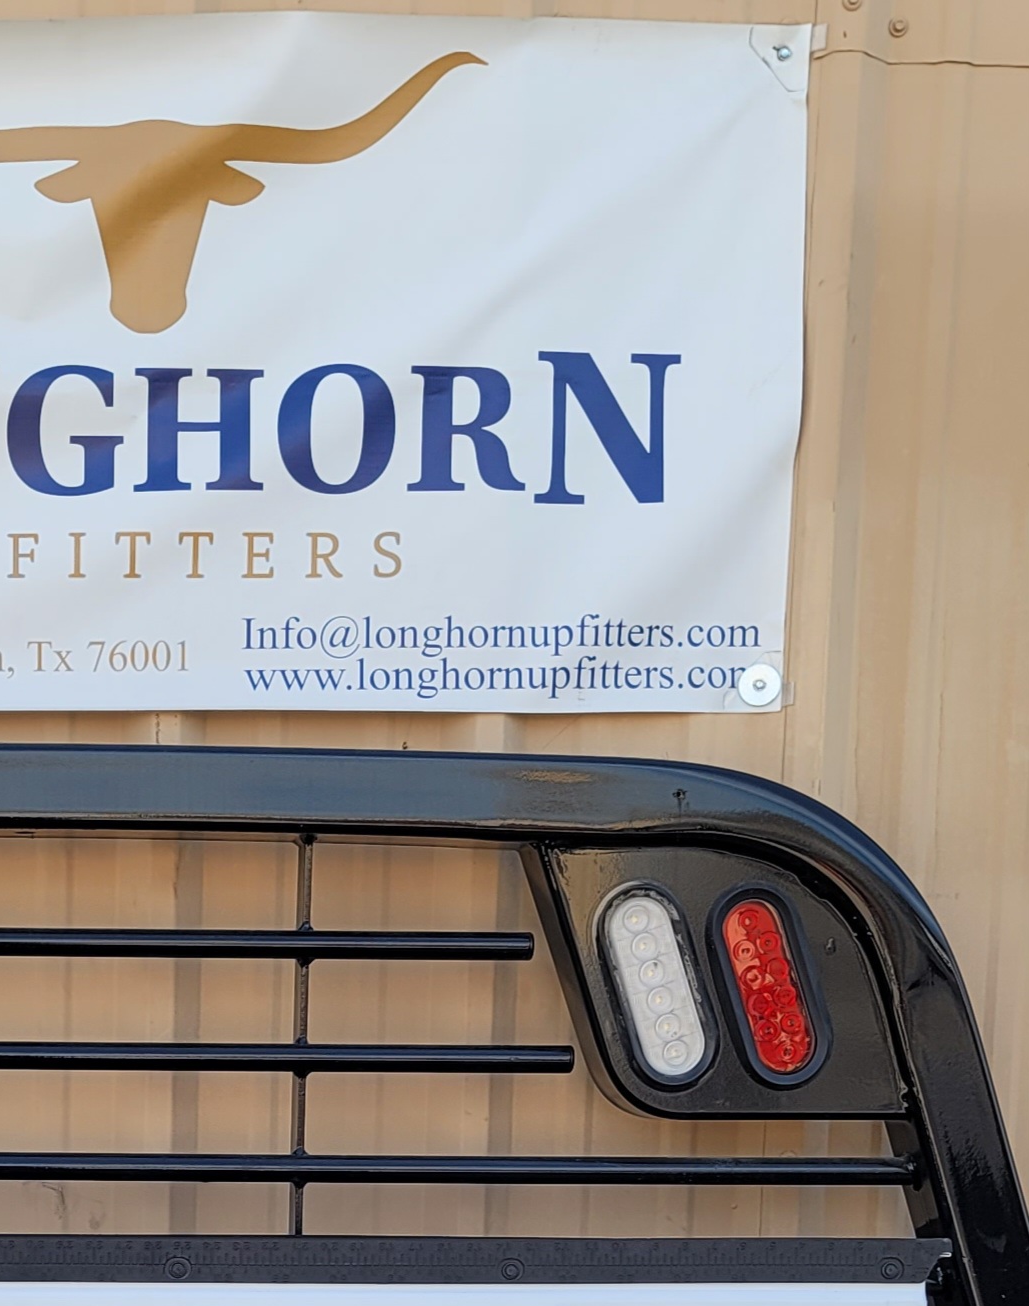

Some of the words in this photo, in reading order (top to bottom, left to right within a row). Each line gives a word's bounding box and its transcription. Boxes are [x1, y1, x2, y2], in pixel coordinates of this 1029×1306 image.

[242, 614, 761, 659] Info@longhornupfitters.com
[27, 641, 73, 672] Tx
[88, 641, 187, 672] 76001
